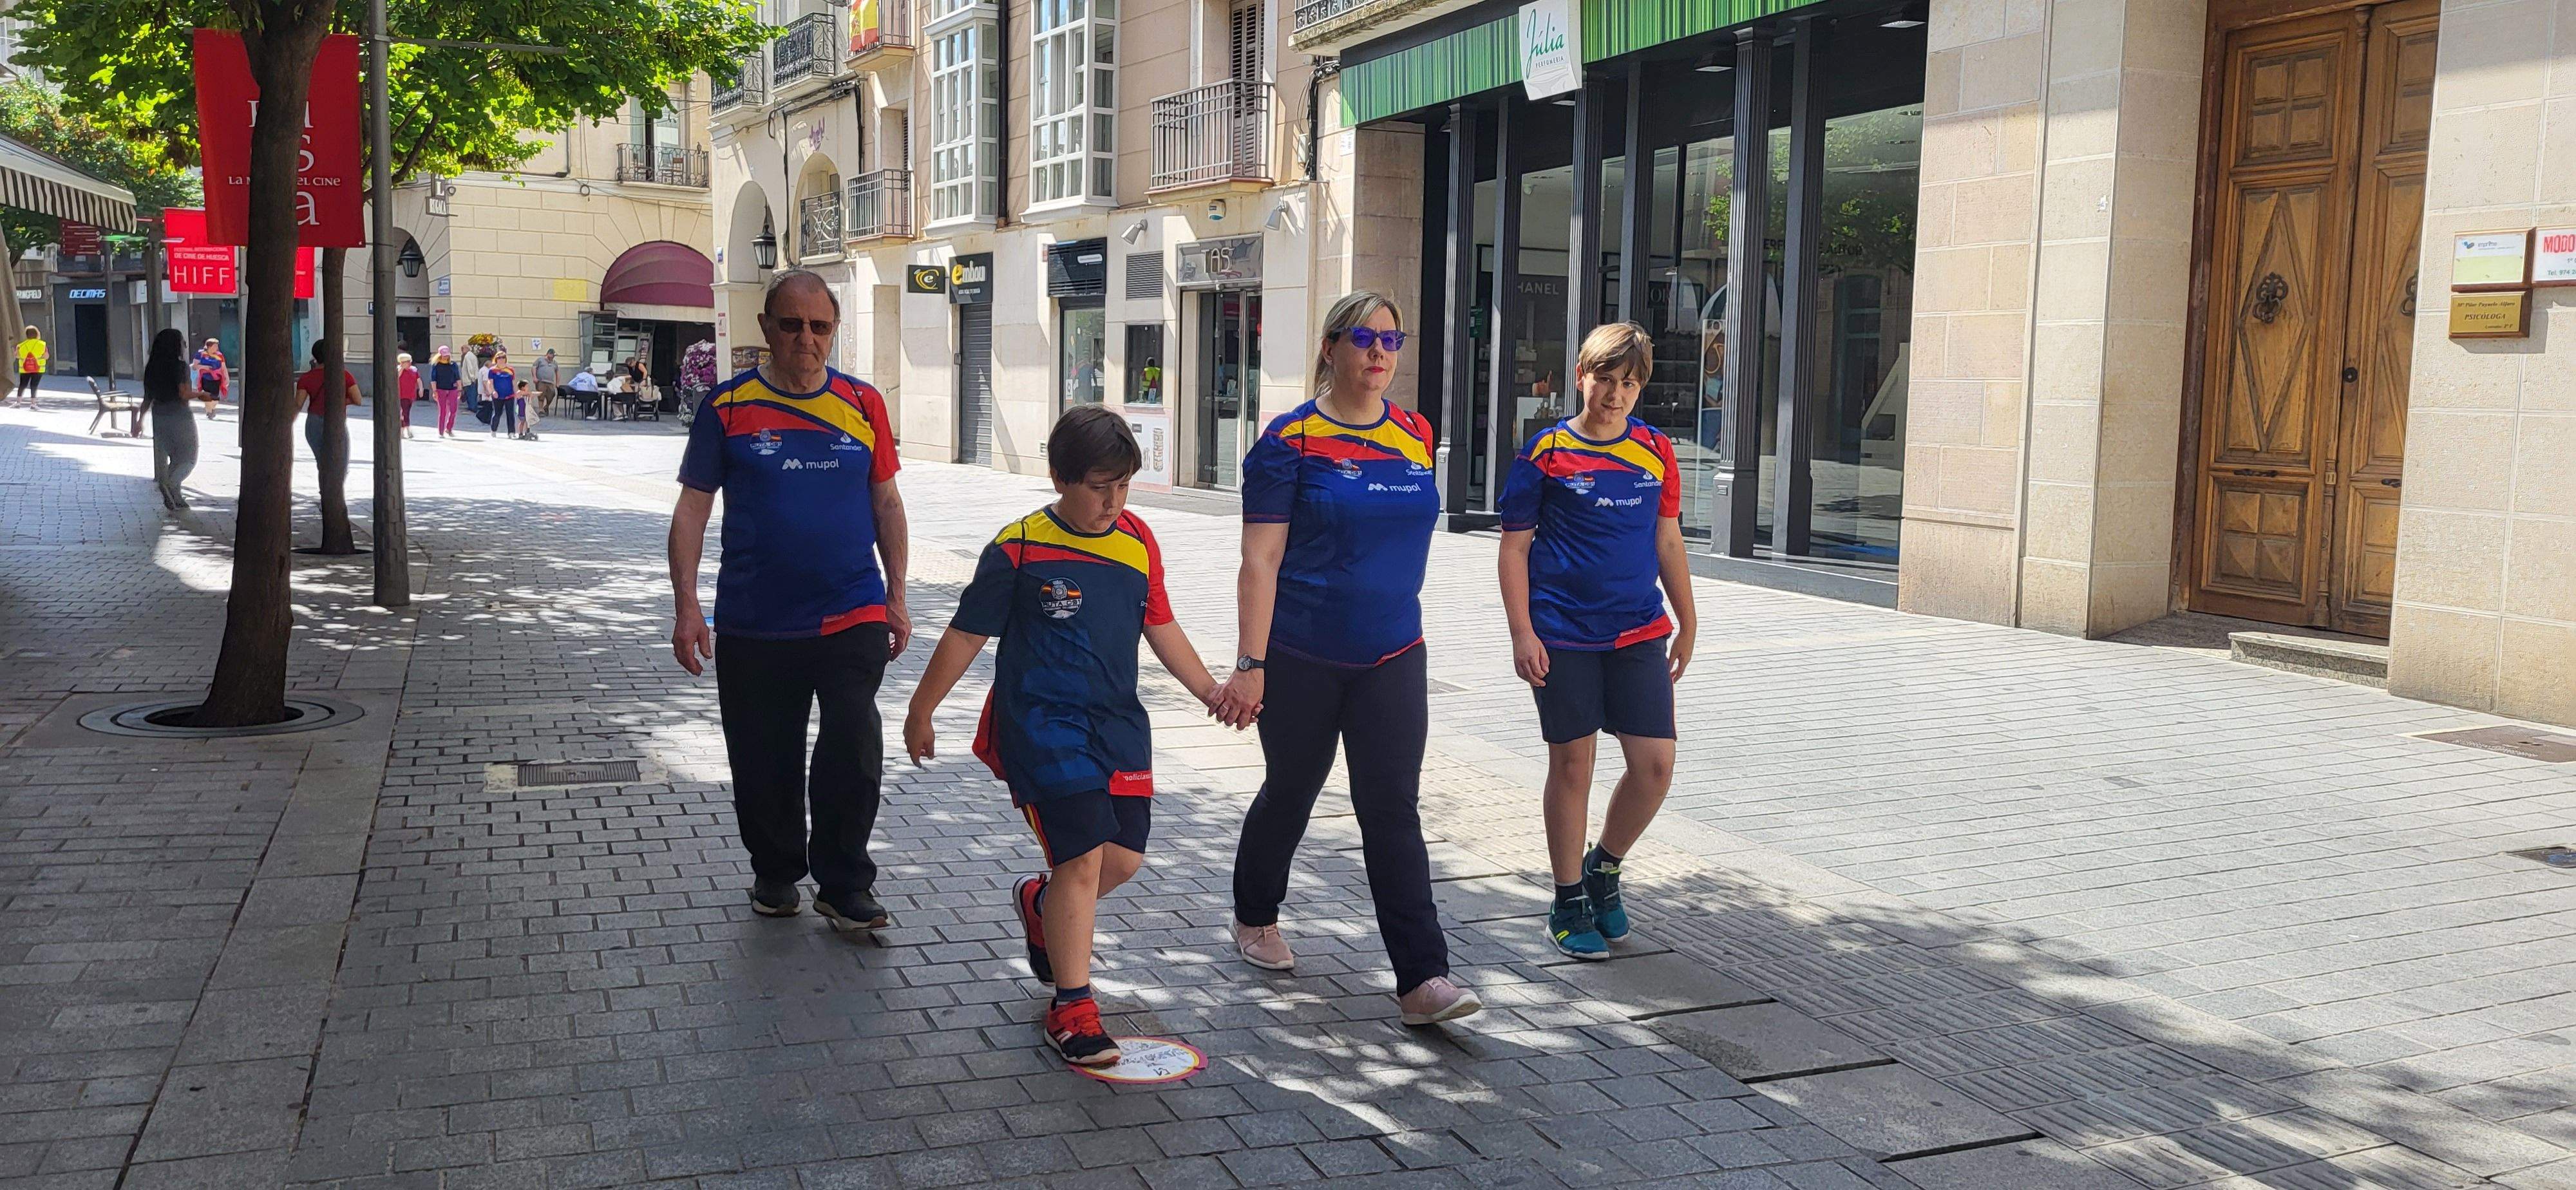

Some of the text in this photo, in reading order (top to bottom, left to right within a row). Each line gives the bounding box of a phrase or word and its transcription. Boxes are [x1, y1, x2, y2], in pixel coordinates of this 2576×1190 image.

[1526, 8, 1564, 80] Júlia
[1535, 55, 1564, 68] PERFUMERIA
[174, 265, 231, 285] HIFF
[951, 260, 986, 285] embou
[806, 458, 840, 471] mupol
[1389, 483, 1422, 494] mupol
[1615, 495, 1642, 507] mupol
